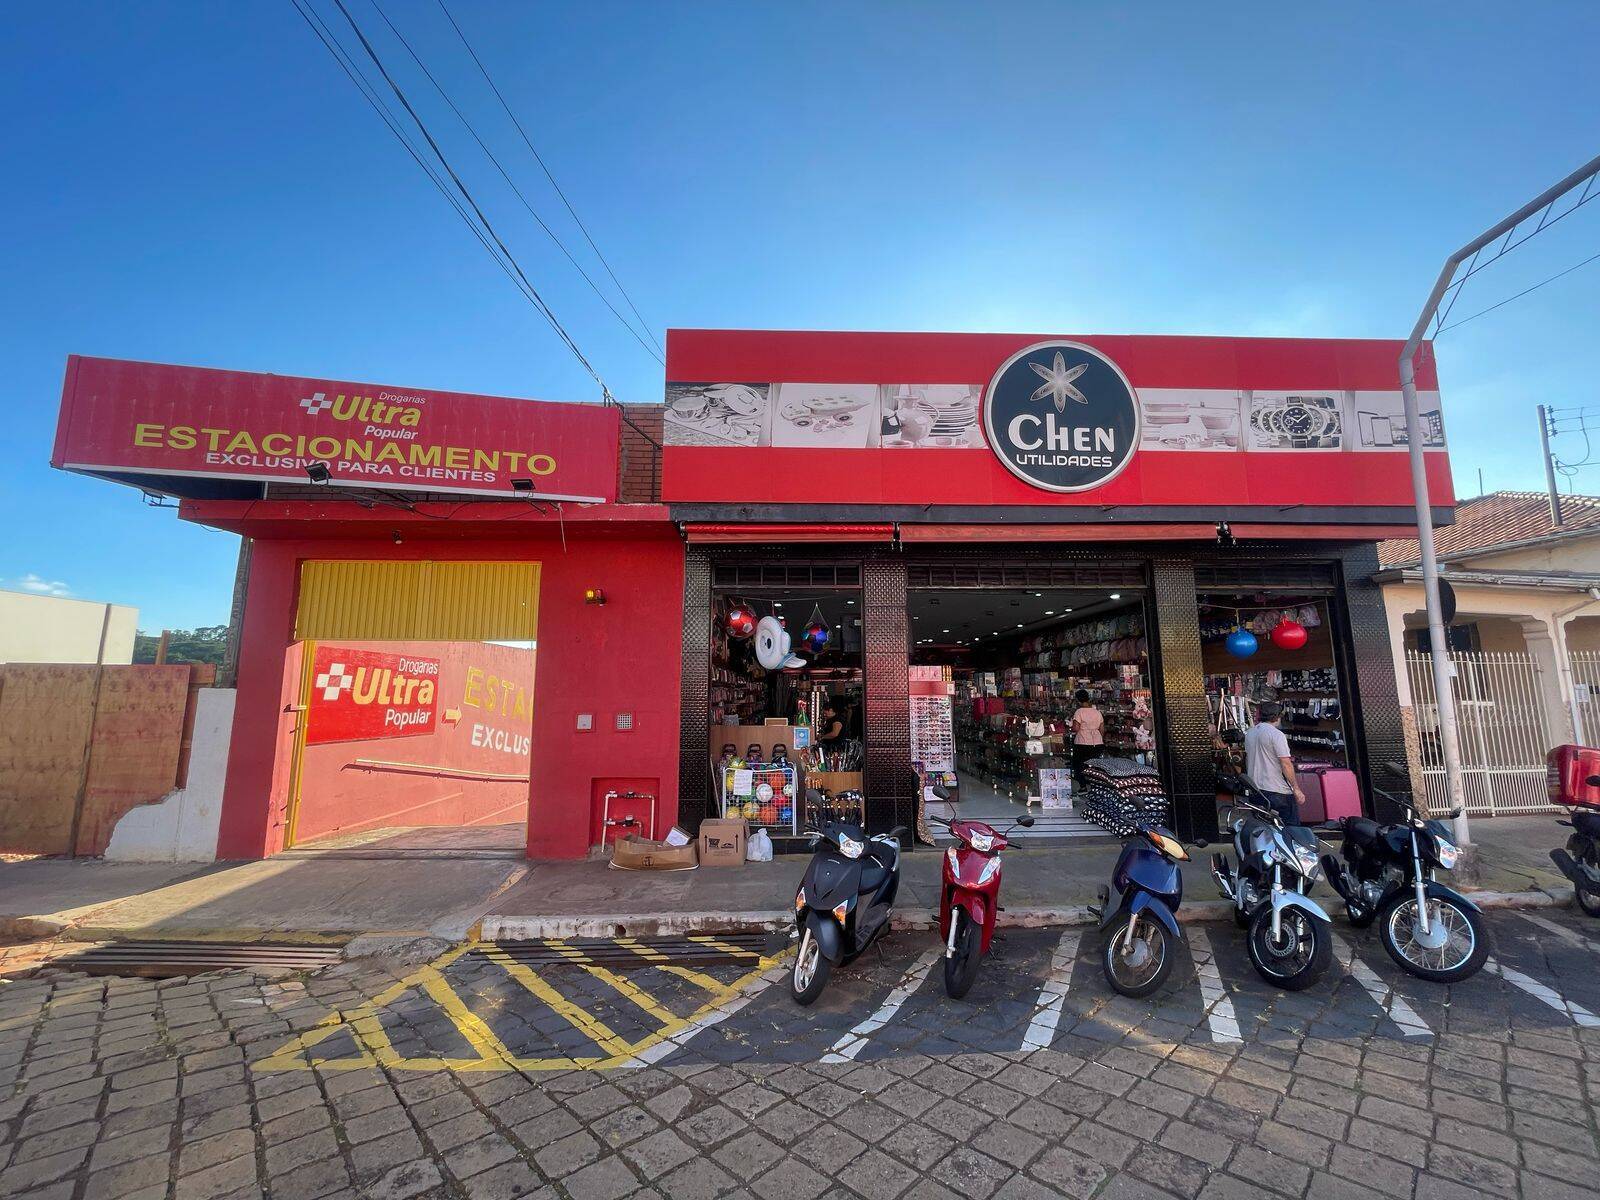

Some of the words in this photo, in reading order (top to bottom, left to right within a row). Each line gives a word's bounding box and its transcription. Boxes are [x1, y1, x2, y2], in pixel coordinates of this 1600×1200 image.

[379, 392, 426, 405] Drogarias
[332, 395, 421, 427] Ultra
[364, 425, 418, 440] Popular
[134, 423, 557, 475] ESTACIONAMENTO
[337, 460, 394, 475] PARA
[399, 465, 496, 483] CLIENTES
[1016, 454, 1113, 468] UTILIDADES
[399, 658, 438, 675] Drogarias
[352, 667, 435, 705] Ultra
[464, 666, 533, 724] ESTA
[385, 708, 431, 730] Popular
[471, 724, 530, 756] EXCLUS
